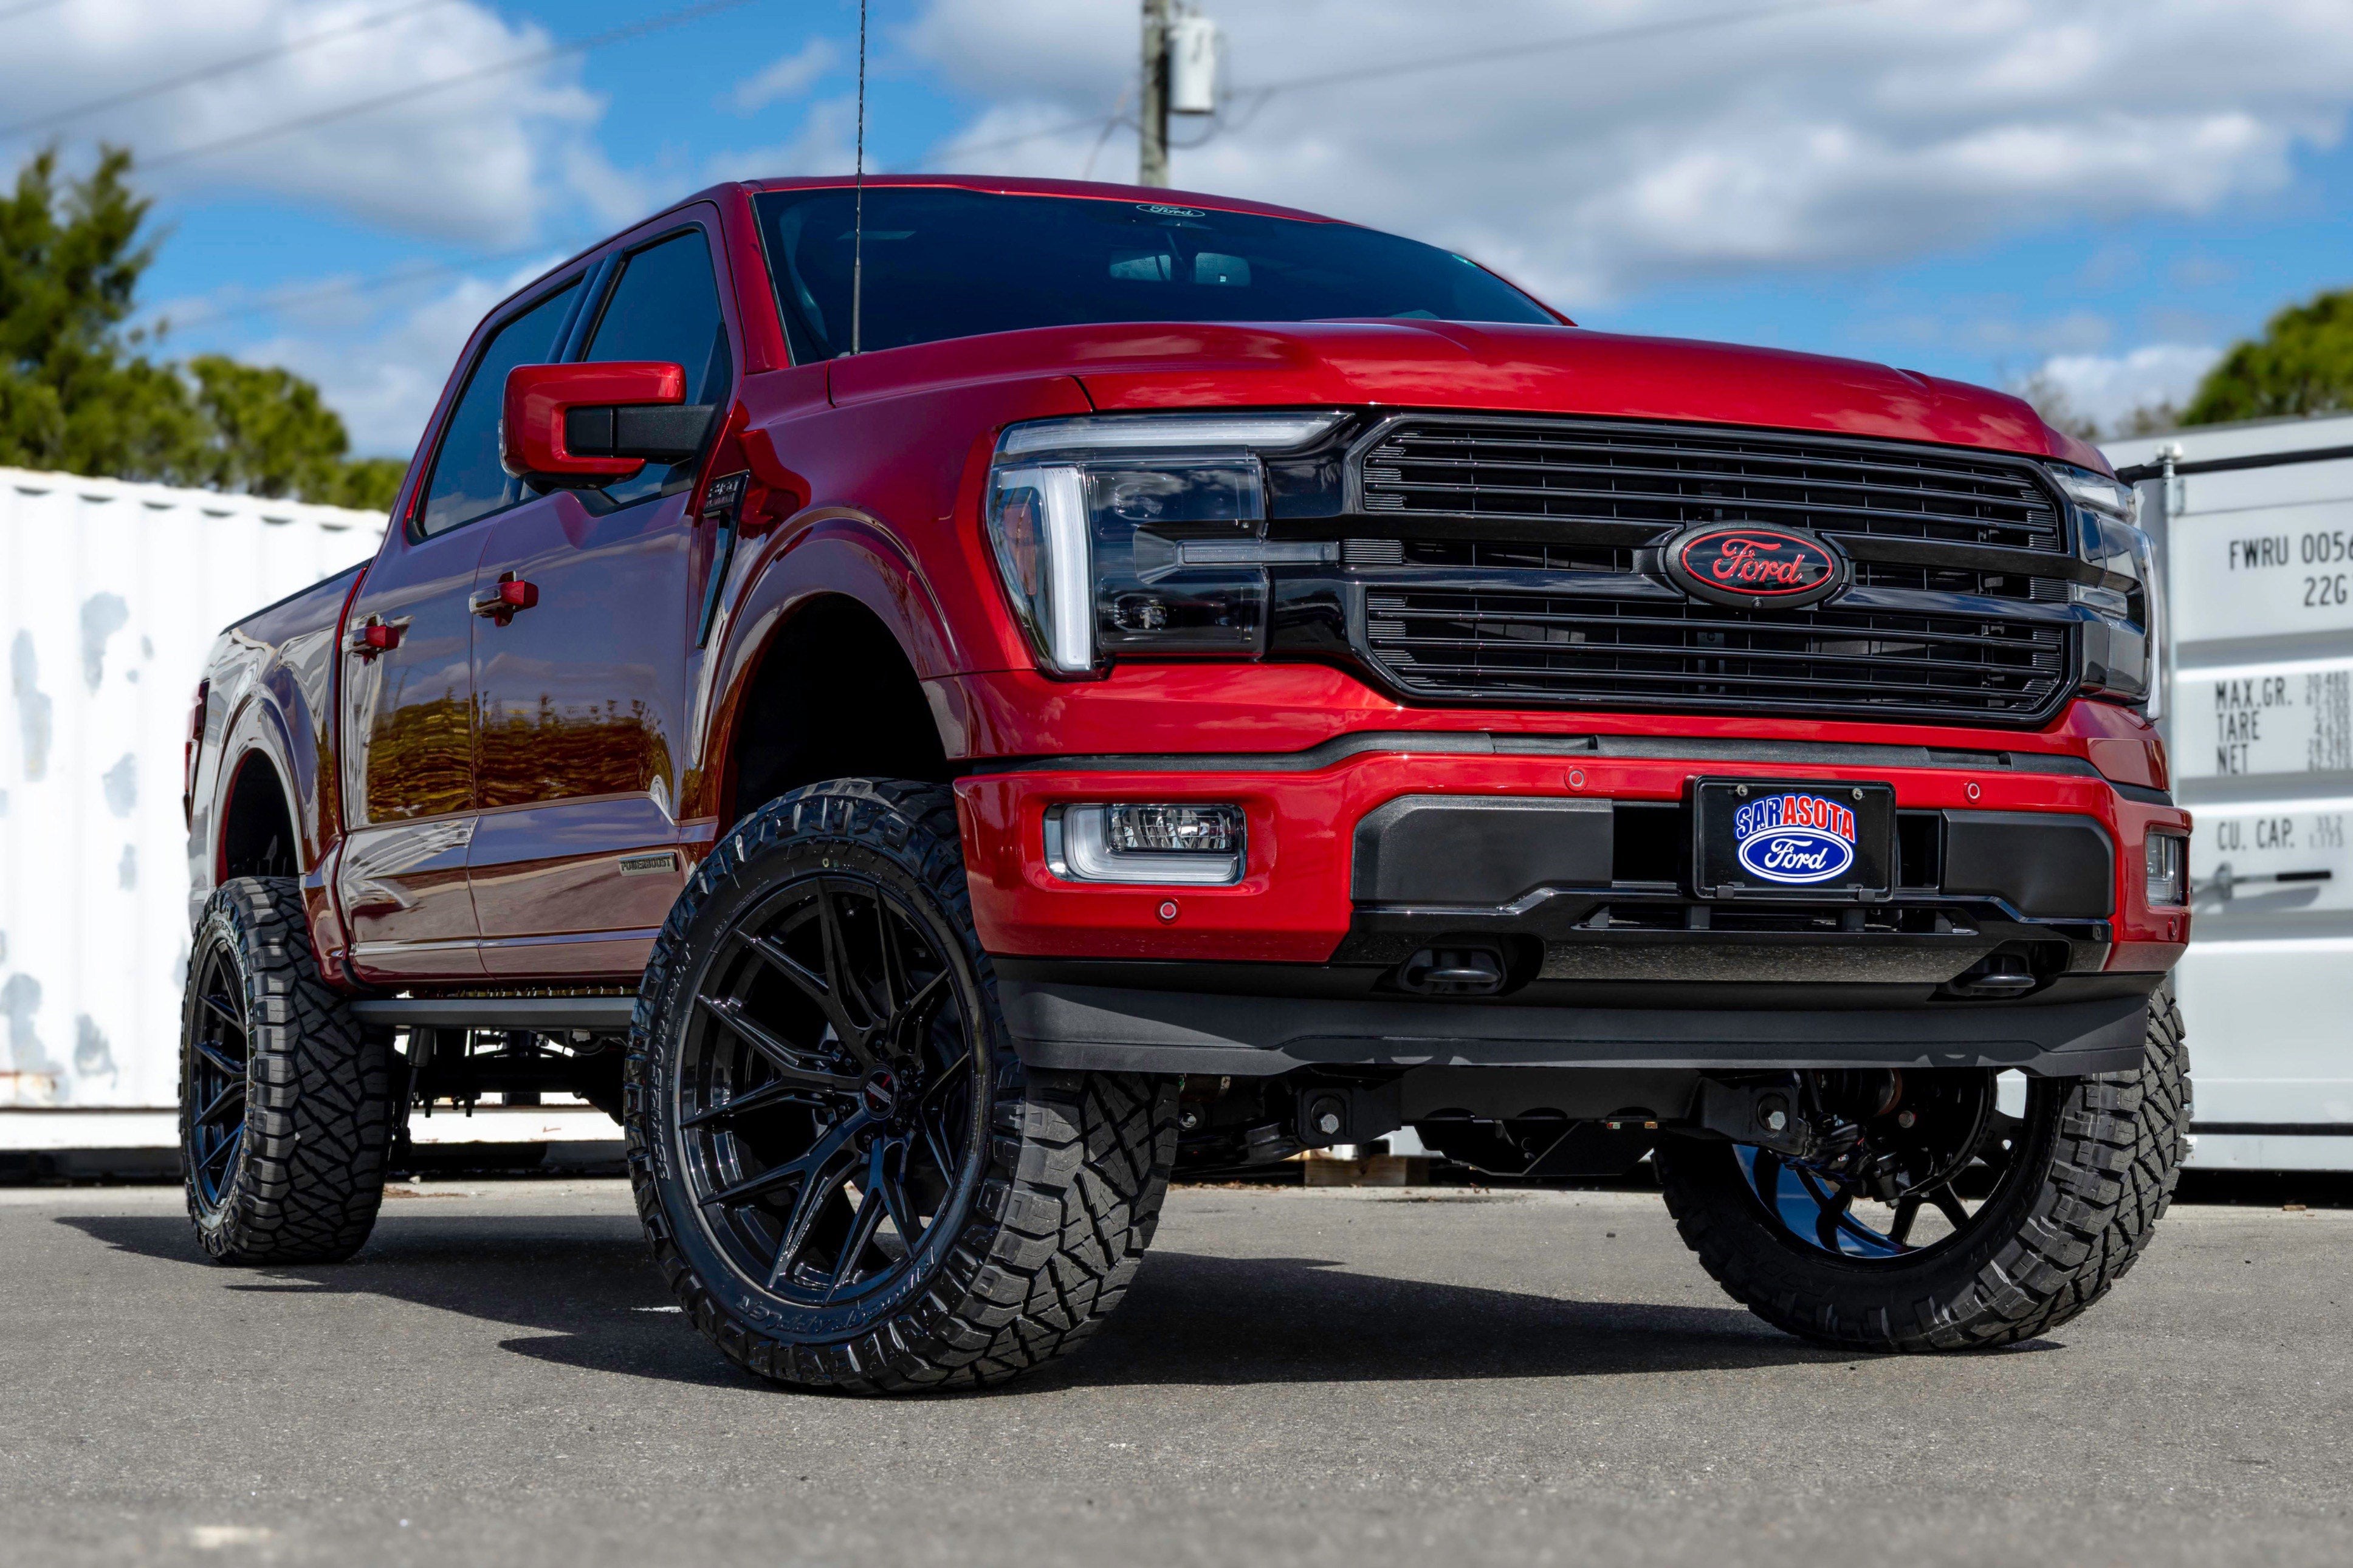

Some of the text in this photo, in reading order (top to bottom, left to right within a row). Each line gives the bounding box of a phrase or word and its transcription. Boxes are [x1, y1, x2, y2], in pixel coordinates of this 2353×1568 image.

[1150, 205, 1194, 216] Ford
[1713, 538, 1805, 584] Ford
[2229, 535, 2289, 570] FWRU
[2217, 710, 2261, 742] TARE
[2217, 743, 2248, 776] NET
[1736, 795, 1856, 844] SARASOTA
[2217, 820, 2247, 851] CU.
[2256, 817, 2296, 849] CAP.
[620, 856, 671, 871] POWERBOOST
[1764, 838, 1829, 869] Ford
